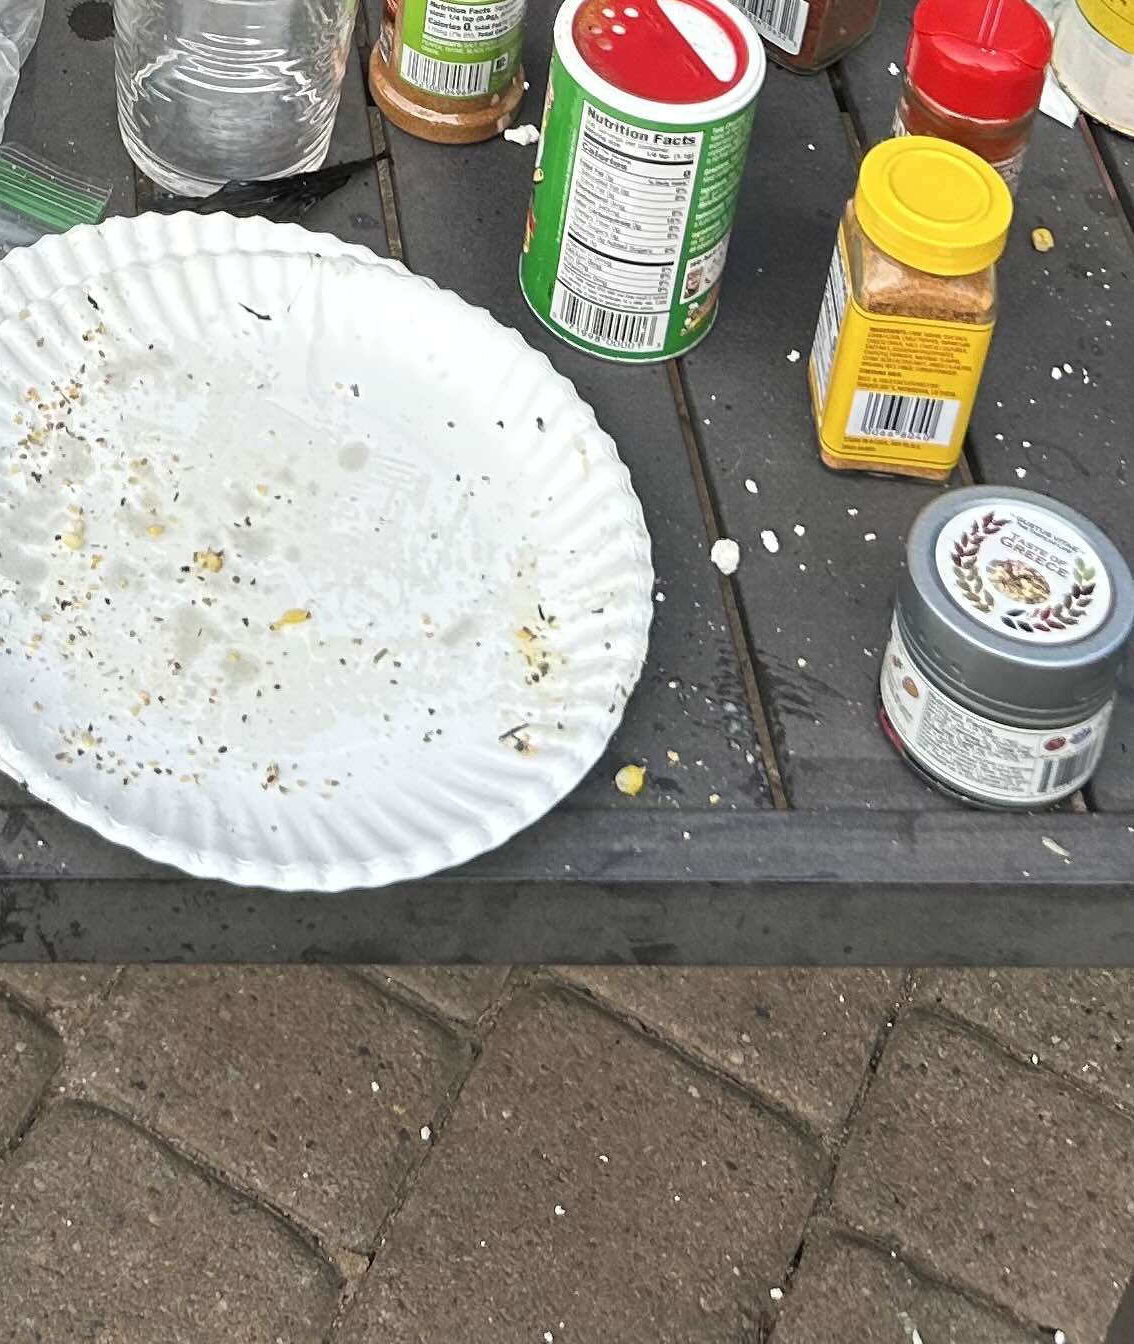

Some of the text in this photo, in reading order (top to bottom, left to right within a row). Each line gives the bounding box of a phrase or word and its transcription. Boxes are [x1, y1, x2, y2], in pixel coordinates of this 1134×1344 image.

[428, 17, 461, 31] Calories
[429, 1, 466, 13] Nutrition
[588, 106, 696, 145] Nutrition Facts
[1000, 536, 1069, 577] GREECE
[1011, 531, 1048, 556] TASTE
[1050, 555, 1068, 565] OF
